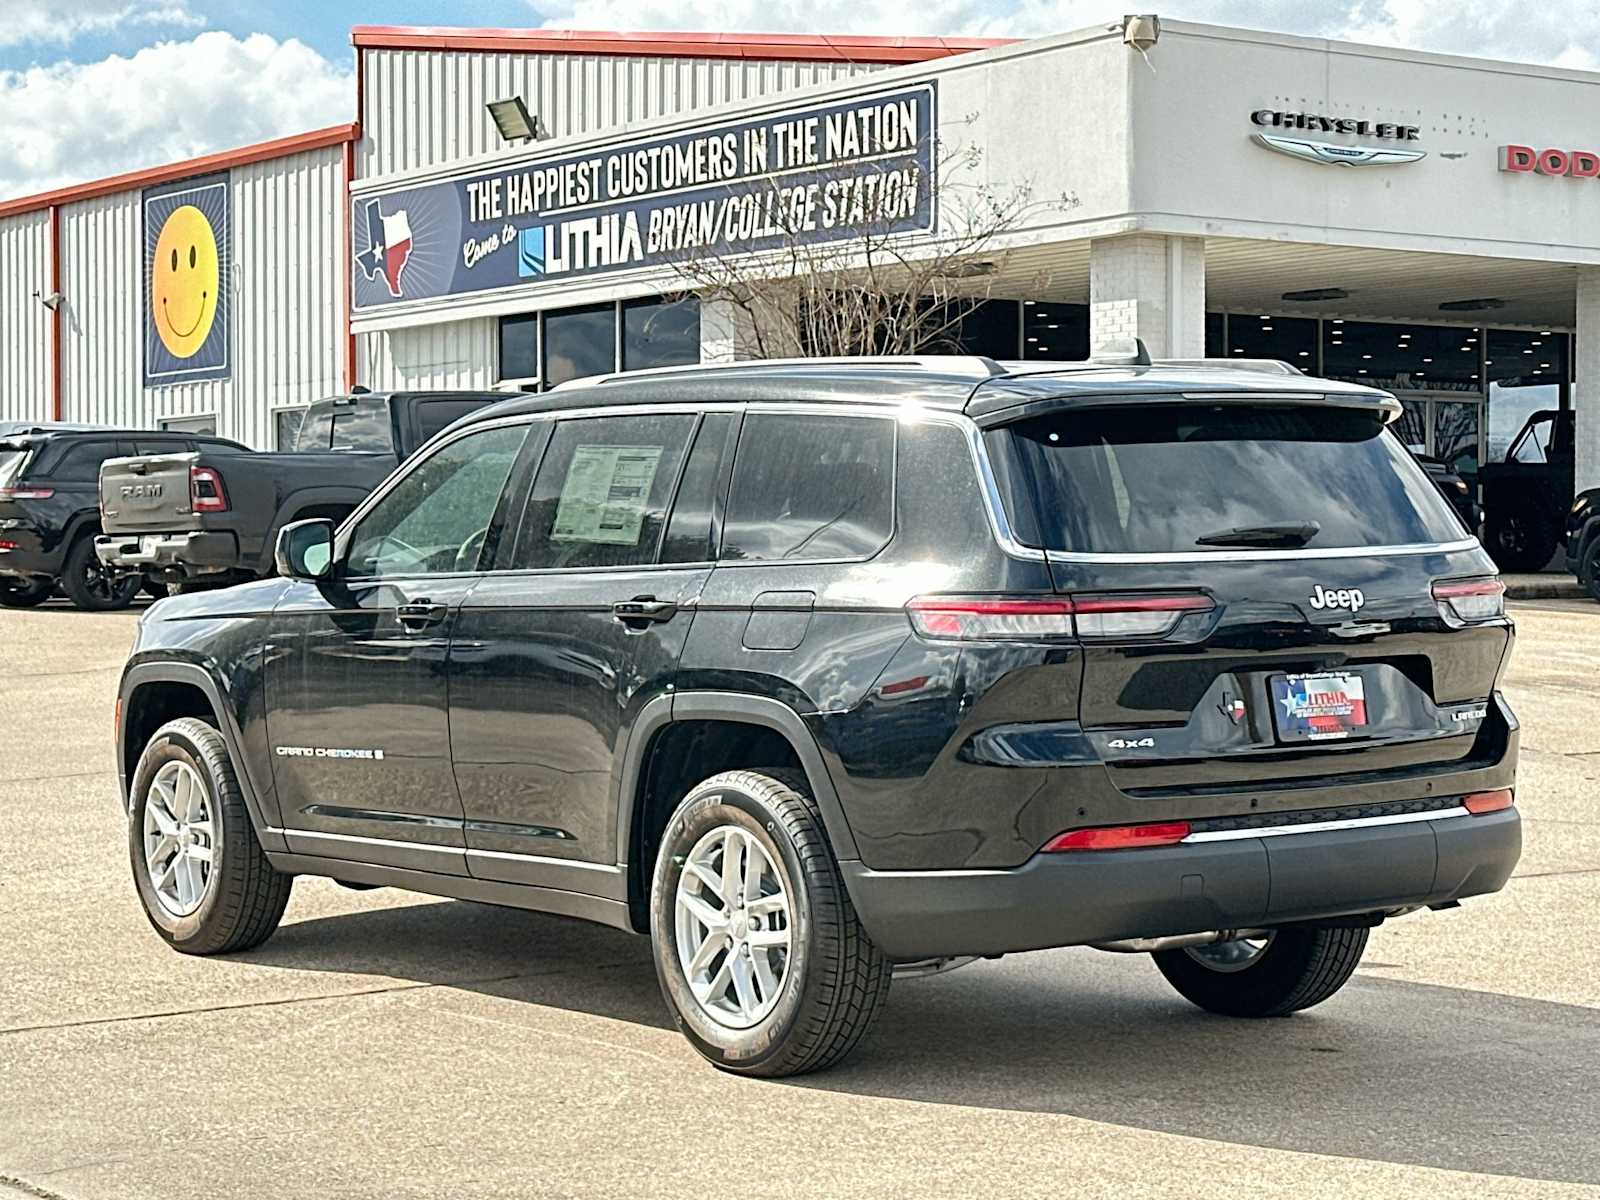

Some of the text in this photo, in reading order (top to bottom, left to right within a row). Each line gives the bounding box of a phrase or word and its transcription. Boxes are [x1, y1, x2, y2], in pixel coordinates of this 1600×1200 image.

[1251, 109, 1421, 140] CHRYSLER
[466, 99, 917, 222] THE HAPPIEST CUSTOMERS IN THE NATION
[463, 168, 919, 274] Come to LITHIA BRYAN/COLLEGE STATION
[120, 484, 162, 501] RAM
[1309, 585, 1364, 612] Jeep
[1308, 691, 1349, 706] LITHIA
[1108, 737, 1154, 748] 4x4
